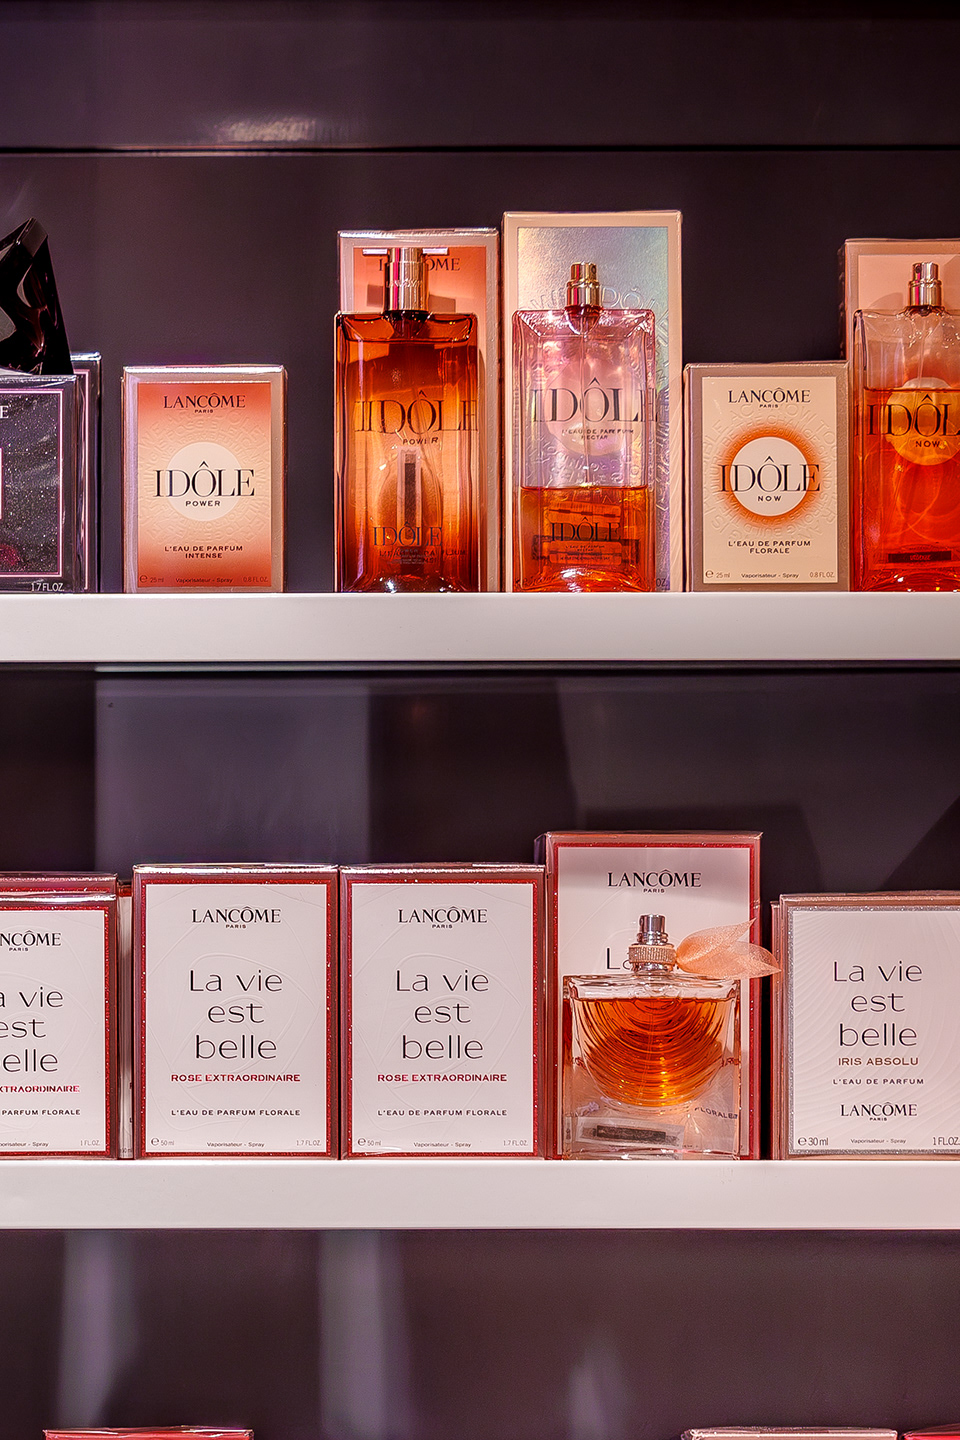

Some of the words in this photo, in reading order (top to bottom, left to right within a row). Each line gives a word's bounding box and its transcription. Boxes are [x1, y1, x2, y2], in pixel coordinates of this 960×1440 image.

[163, 393, 246, 409] LANCÔME
[728, 387, 811, 404] LANCÔME
[154, 461, 255, 497] IDÔLE
[718, 456, 820, 492] IDÔLE
[607, 870, 701, 888] LANCÔME
[192, 907, 281, 924] LANCÔME
[398, 907, 487, 924] LANCÔME
[190, 970, 222, 992] La
[236, 969, 283, 992] vie
[396, 970, 428, 992] La
[443, 969, 489, 992] vie
[833, 961, 865, 982] La
[877, 960, 923, 982] vie
[19, 986, 63, 1008] vie
[850, 992, 905, 1013] est
[207, 1003, 264, 1024] est
[414, 1003, 471, 1024] est
[839, 1023, 917, 1047] belle
[195, 1034, 277, 1059] belle
[402, 1034, 483, 1059] belle
[838, 1058, 862, 1066] IRIS
[866, 1058, 919, 1066] ABSOLU
[377, 1074, 409, 1082] ROSE
[412, 1074, 507, 1082] EXTRAORDINAIRE
[840, 1102, 917, 1117] LANCÔME
